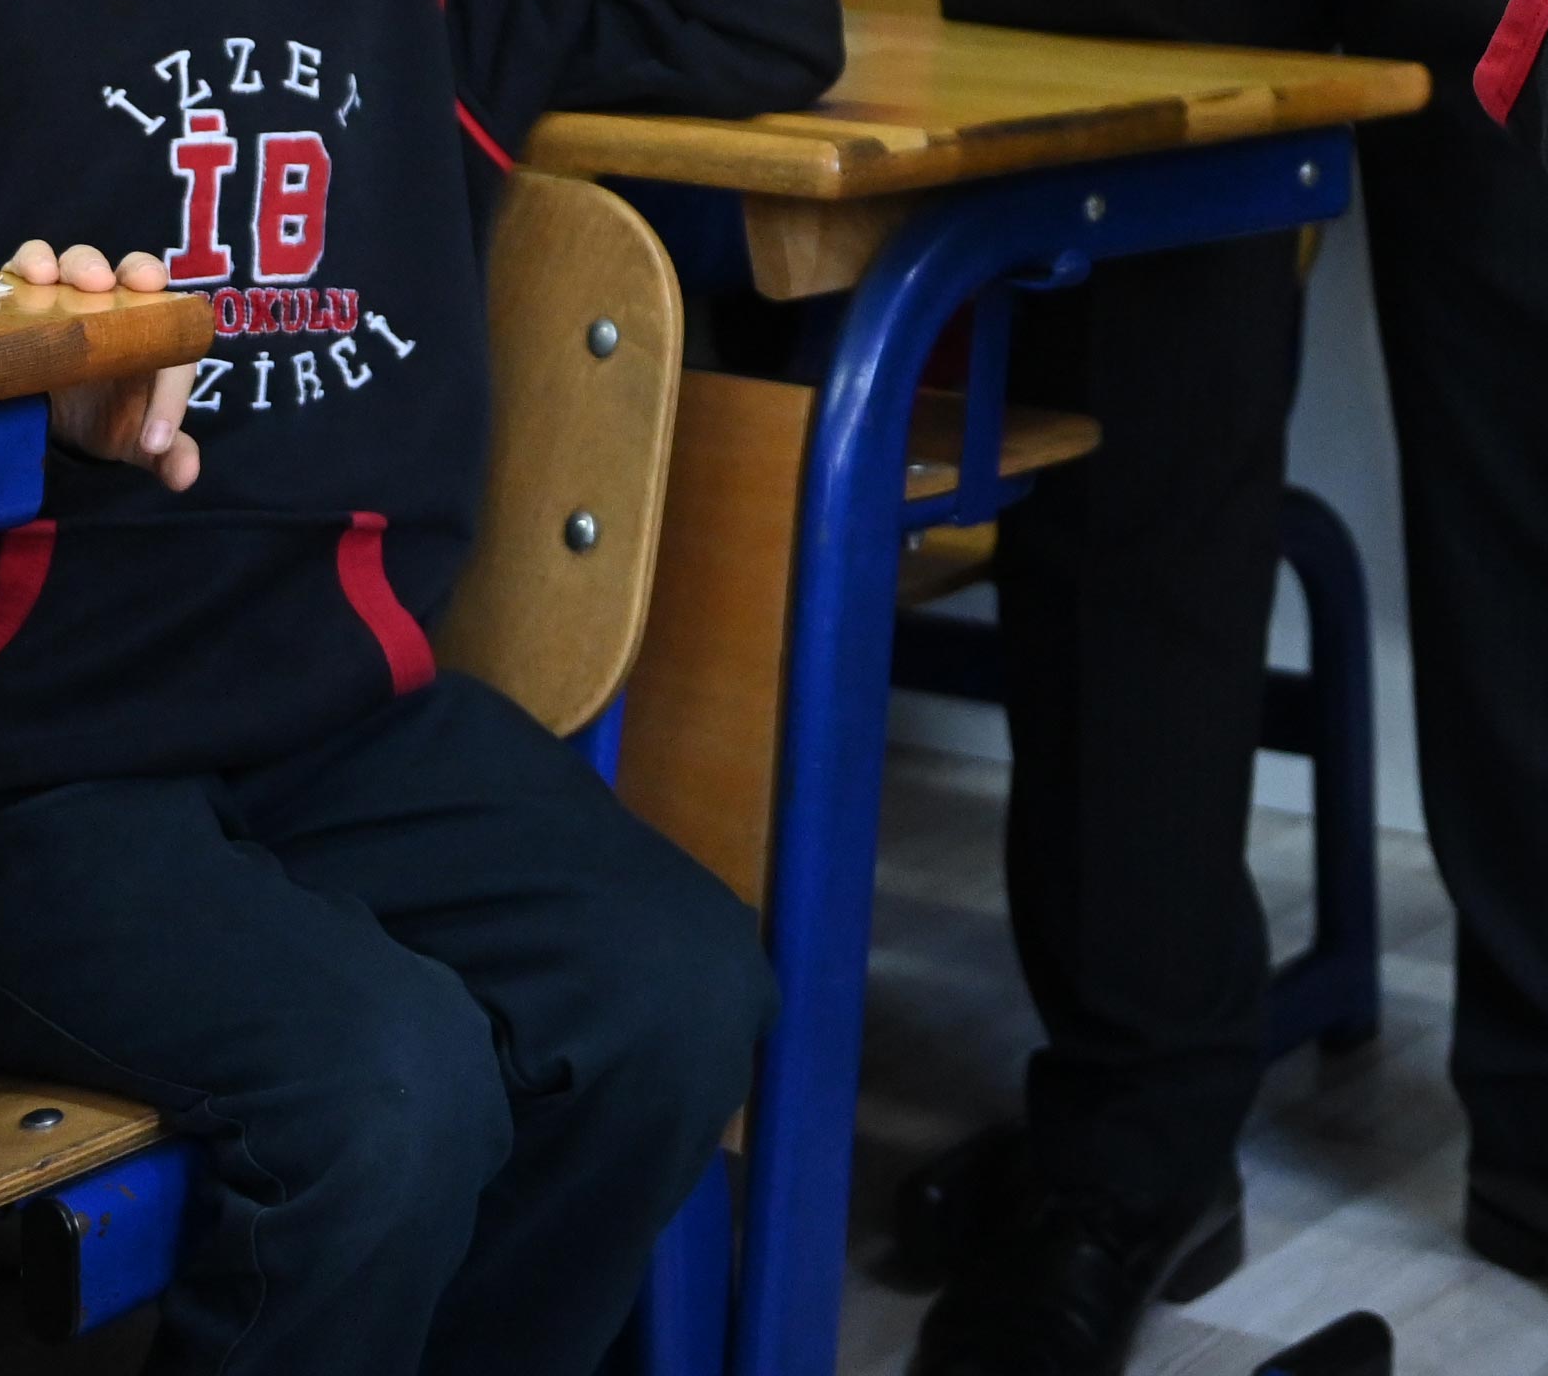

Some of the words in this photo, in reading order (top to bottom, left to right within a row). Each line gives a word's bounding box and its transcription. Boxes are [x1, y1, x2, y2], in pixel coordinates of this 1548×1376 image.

[163, 108, 333, 286] İB
[187, 310, 417, 412] ZİRCİ
[207, 287, 359, 337] OKULU
